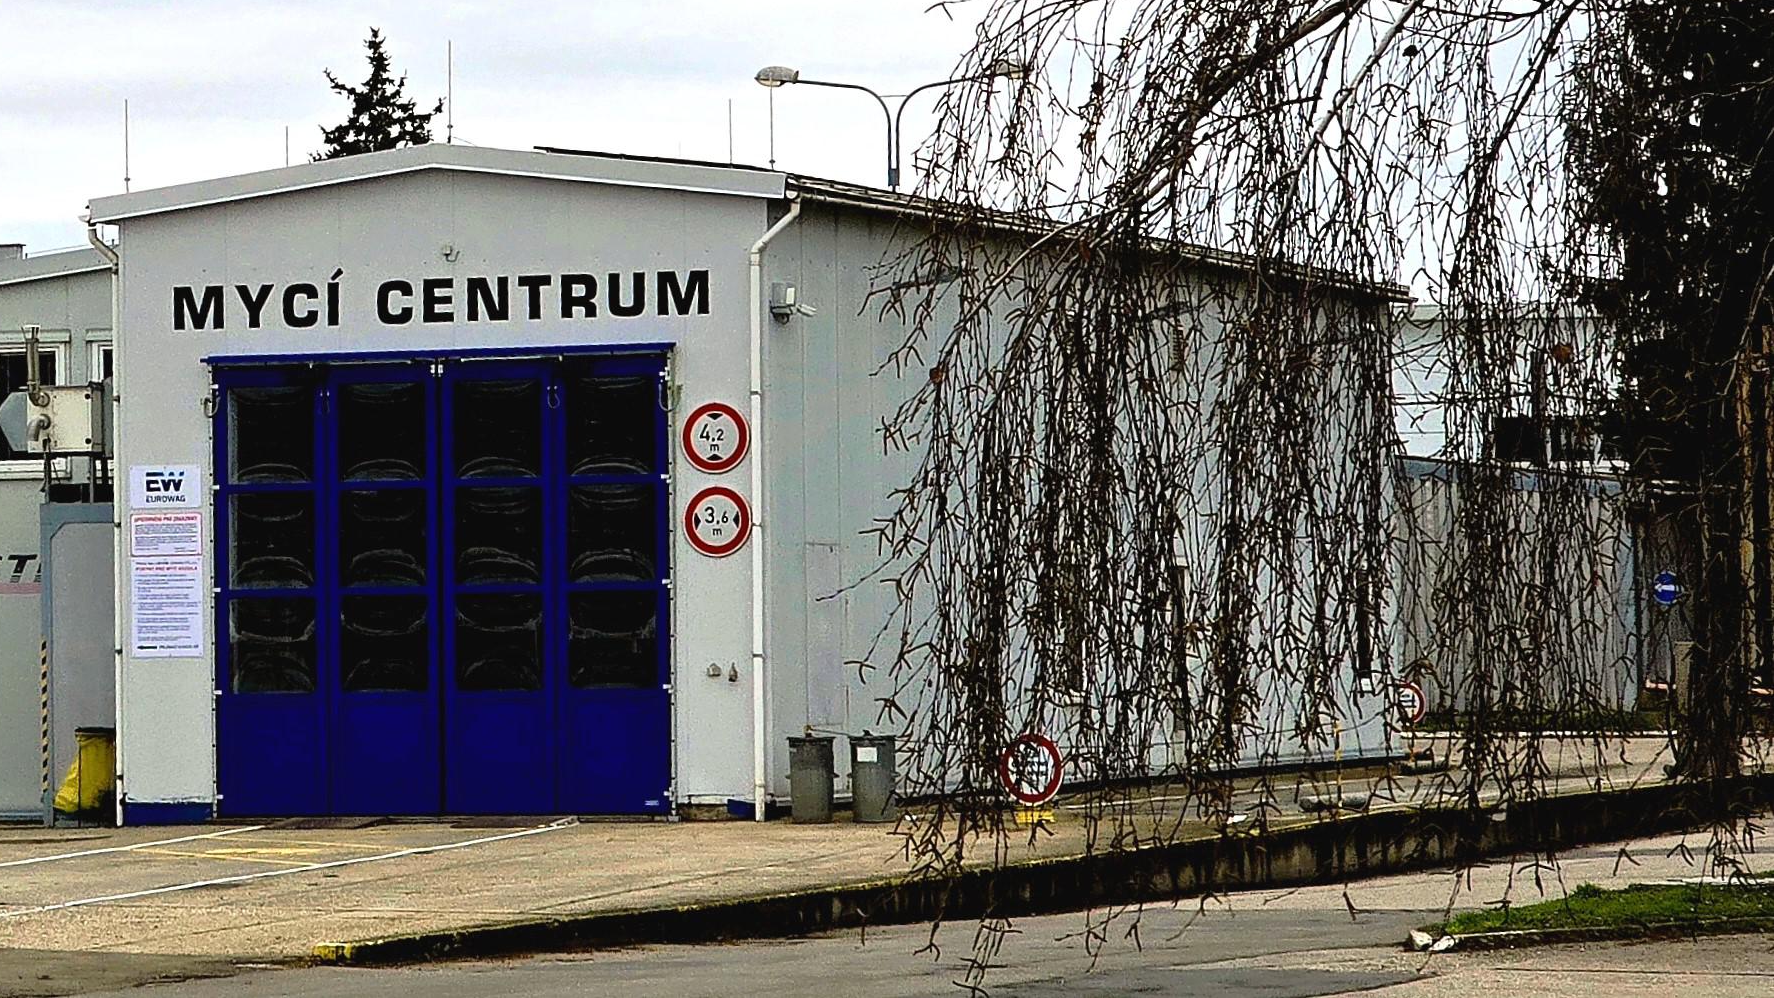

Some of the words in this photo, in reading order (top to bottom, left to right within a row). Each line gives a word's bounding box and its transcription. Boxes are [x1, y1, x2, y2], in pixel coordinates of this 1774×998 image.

[172, 268, 340, 330] MYCÍ
[376, 269, 710, 325] CENTRUM
[699, 423, 724, 443] 4,2
[710, 443, 720, 452] m
[145, 470, 185, 493] EW
[145, 495, 186, 504] EUROWAG
[705, 506, 729, 525] 3,6
[712, 527, 723, 536] m
